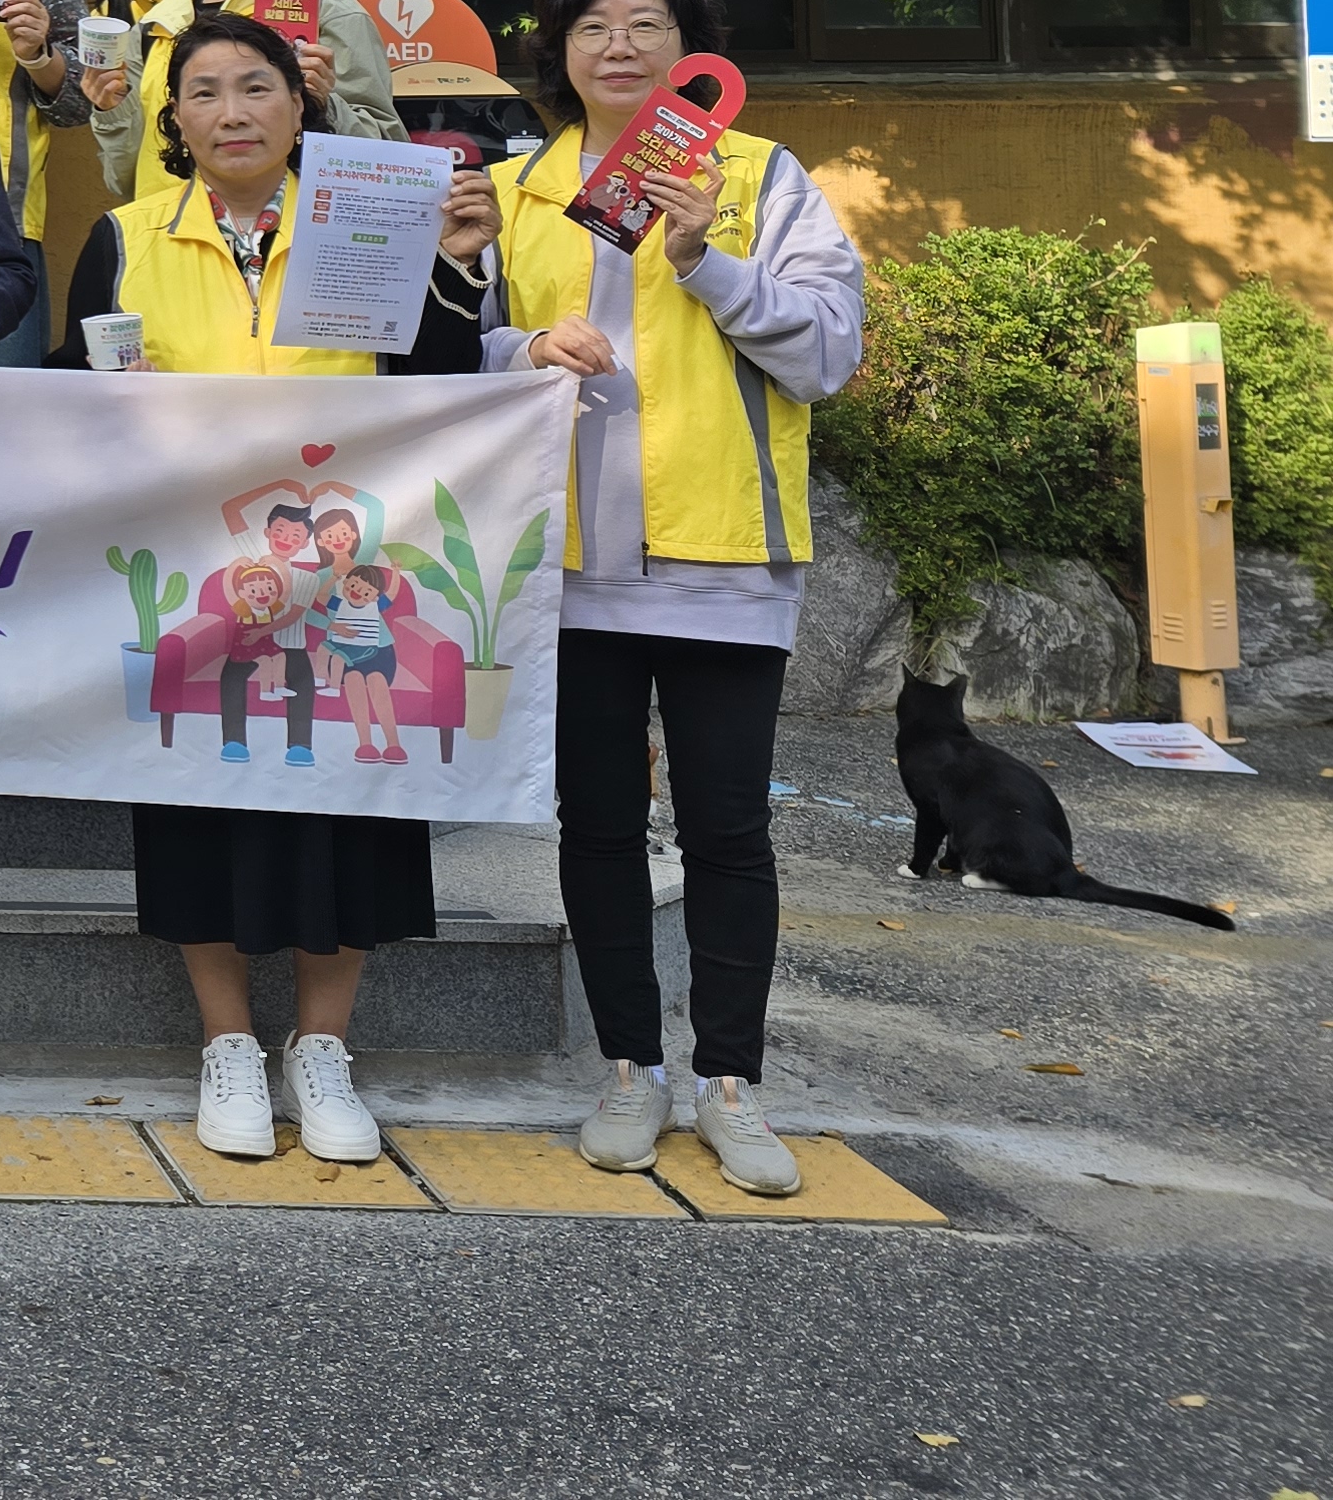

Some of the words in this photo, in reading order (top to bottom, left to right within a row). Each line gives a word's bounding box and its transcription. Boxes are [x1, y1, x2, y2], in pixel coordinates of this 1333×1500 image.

[386, 42, 433, 61] AED
[635, 128, 692, 167] 보건·복지
[652, 122, 691, 150] 찾아가는
[327, 157, 344, 168] 우리
[347, 159, 372, 170] 주변의
[375, 163, 432, 177] 복지위기가구와
[636, 146, 673, 174] 서비스
[395, 174, 440, 190] 알려주세요!
